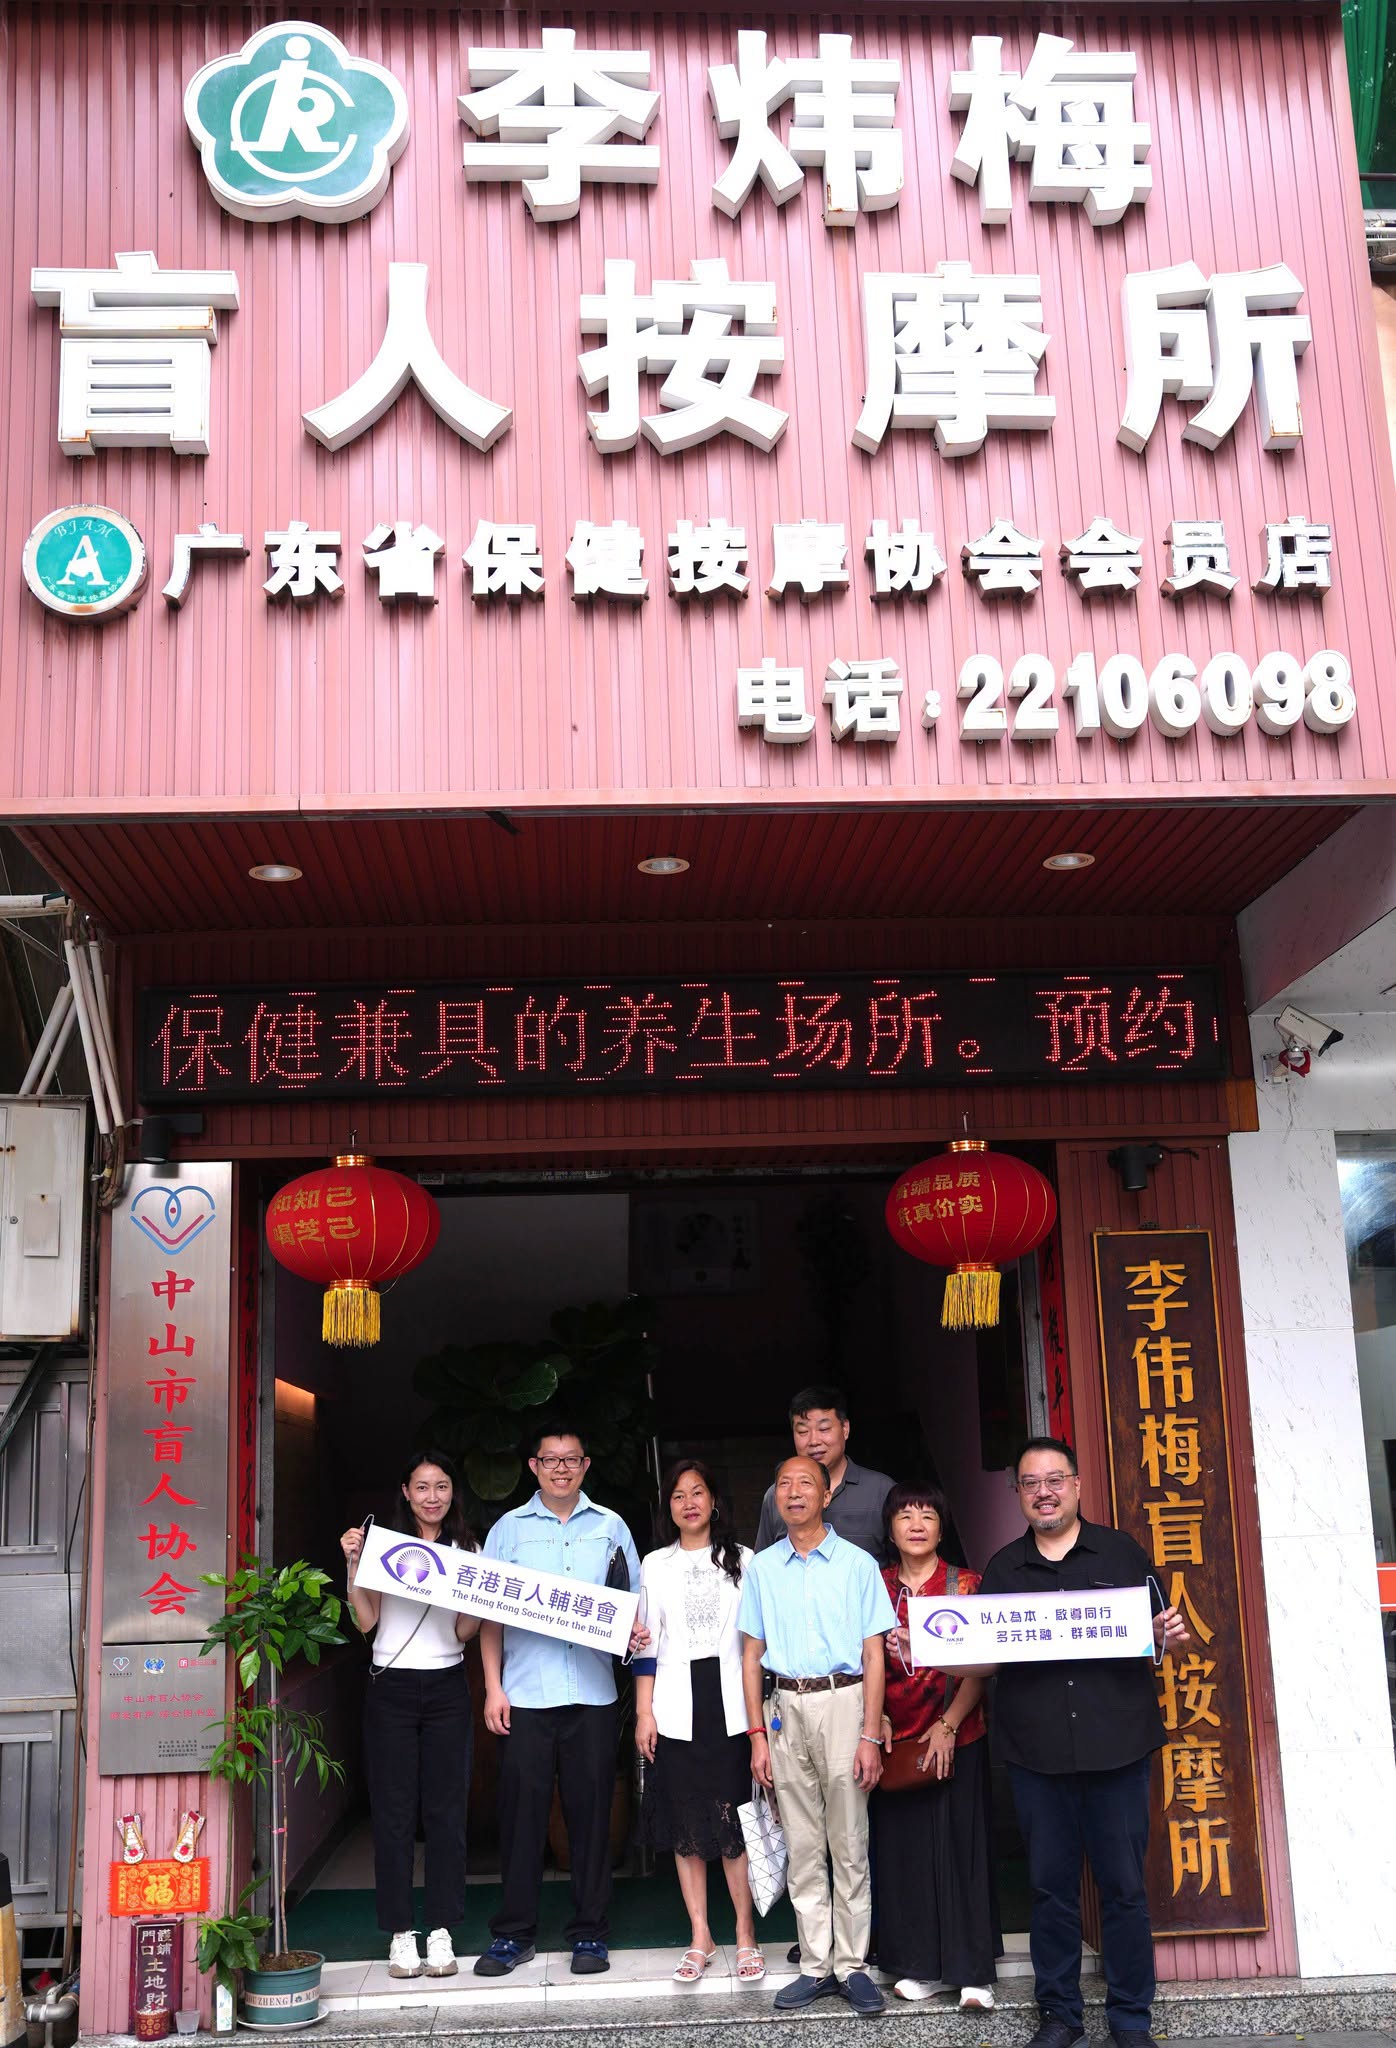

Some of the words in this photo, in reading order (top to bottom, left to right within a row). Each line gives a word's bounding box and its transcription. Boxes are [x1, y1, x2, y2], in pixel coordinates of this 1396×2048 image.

[457, 28, 1153, 227] 李炜梅
[31, 251, 1311, 458] 盲人按摩所
[54, 519, 117, 538] BJAM
[162, 516, 1334, 607] 广东省保健按摩协会会员店
[151, 987, 1218, 1086] 保健兼具的养生场所。预约
[896, 1194, 984, 1227] 货真价实
[137, 1270, 200, 1615] 中山市盲人协会
[405, 1584, 432, 1596] HKSB
[451, 1589, 469, 1600] The
[470, 1593, 495, 1609] Hong
[496, 1600, 520, 1615] Kong
[521, 1608, 555, 1624] Society
[556, 1616, 570, 1628] for
[571, 1621, 586, 1631] the
[588, 1625, 613, 1638] Blind
[456, 1564, 618, 1625] 香港盲人輔導會
[1125, 1260, 1232, 1898] 李伟梅盲人按摩所
[144, 1873, 175, 1905] 福
